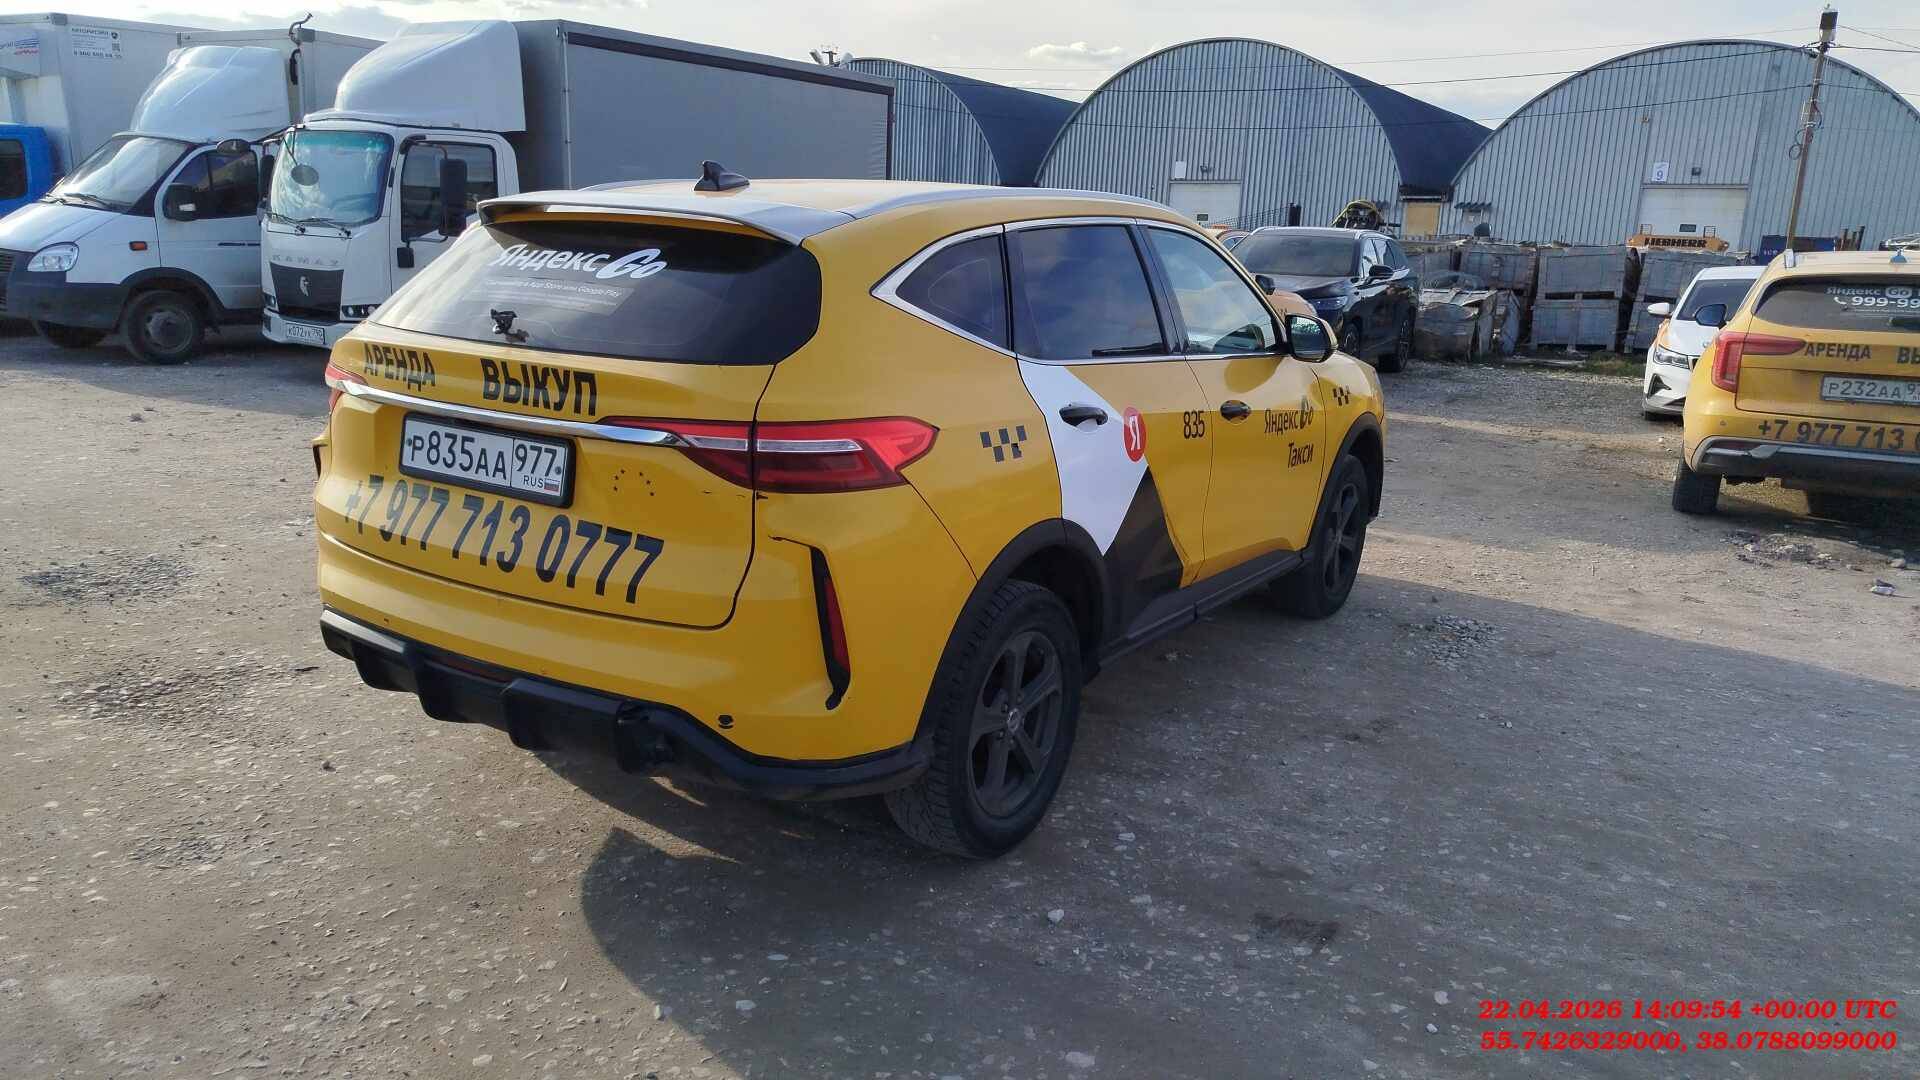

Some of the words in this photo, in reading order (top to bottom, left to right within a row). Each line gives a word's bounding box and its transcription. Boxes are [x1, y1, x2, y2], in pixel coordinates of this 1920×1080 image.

[1656, 169, 1664, 181] 9
[1644, 237, 1707, 248] LIEBHERR
[487, 243, 611, 273] Яндекс
[595, 248, 668, 279] Go
[1826, 286, 1881, 296] Яндекс
[1804, 343, 1872, 361] АРЕНДА
[363, 342, 437, 391] АРЕНДА
[480, 358, 597, 417] ВЫКУП
[1828, 380, 1900, 398] Р232АА
[1183, 410, 1206, 440] 835
[1264, 408, 1299, 437] Яндекс
[1758, 419, 1789, 440] +7
[1797, 421, 1847, 446] 977
[1855, 425, 1905, 450] 713
[410, 430, 508, 481] Р835АА
[514, 443, 558, 477] 977
[1288, 442, 1315, 469] Такси
[523, 474, 544, 489] RUS
[345, 473, 384, 535] +7
[379, 479, 450, 552] 977
[452, 493, 531, 573] 713
[535, 513, 665, 604] 0777
